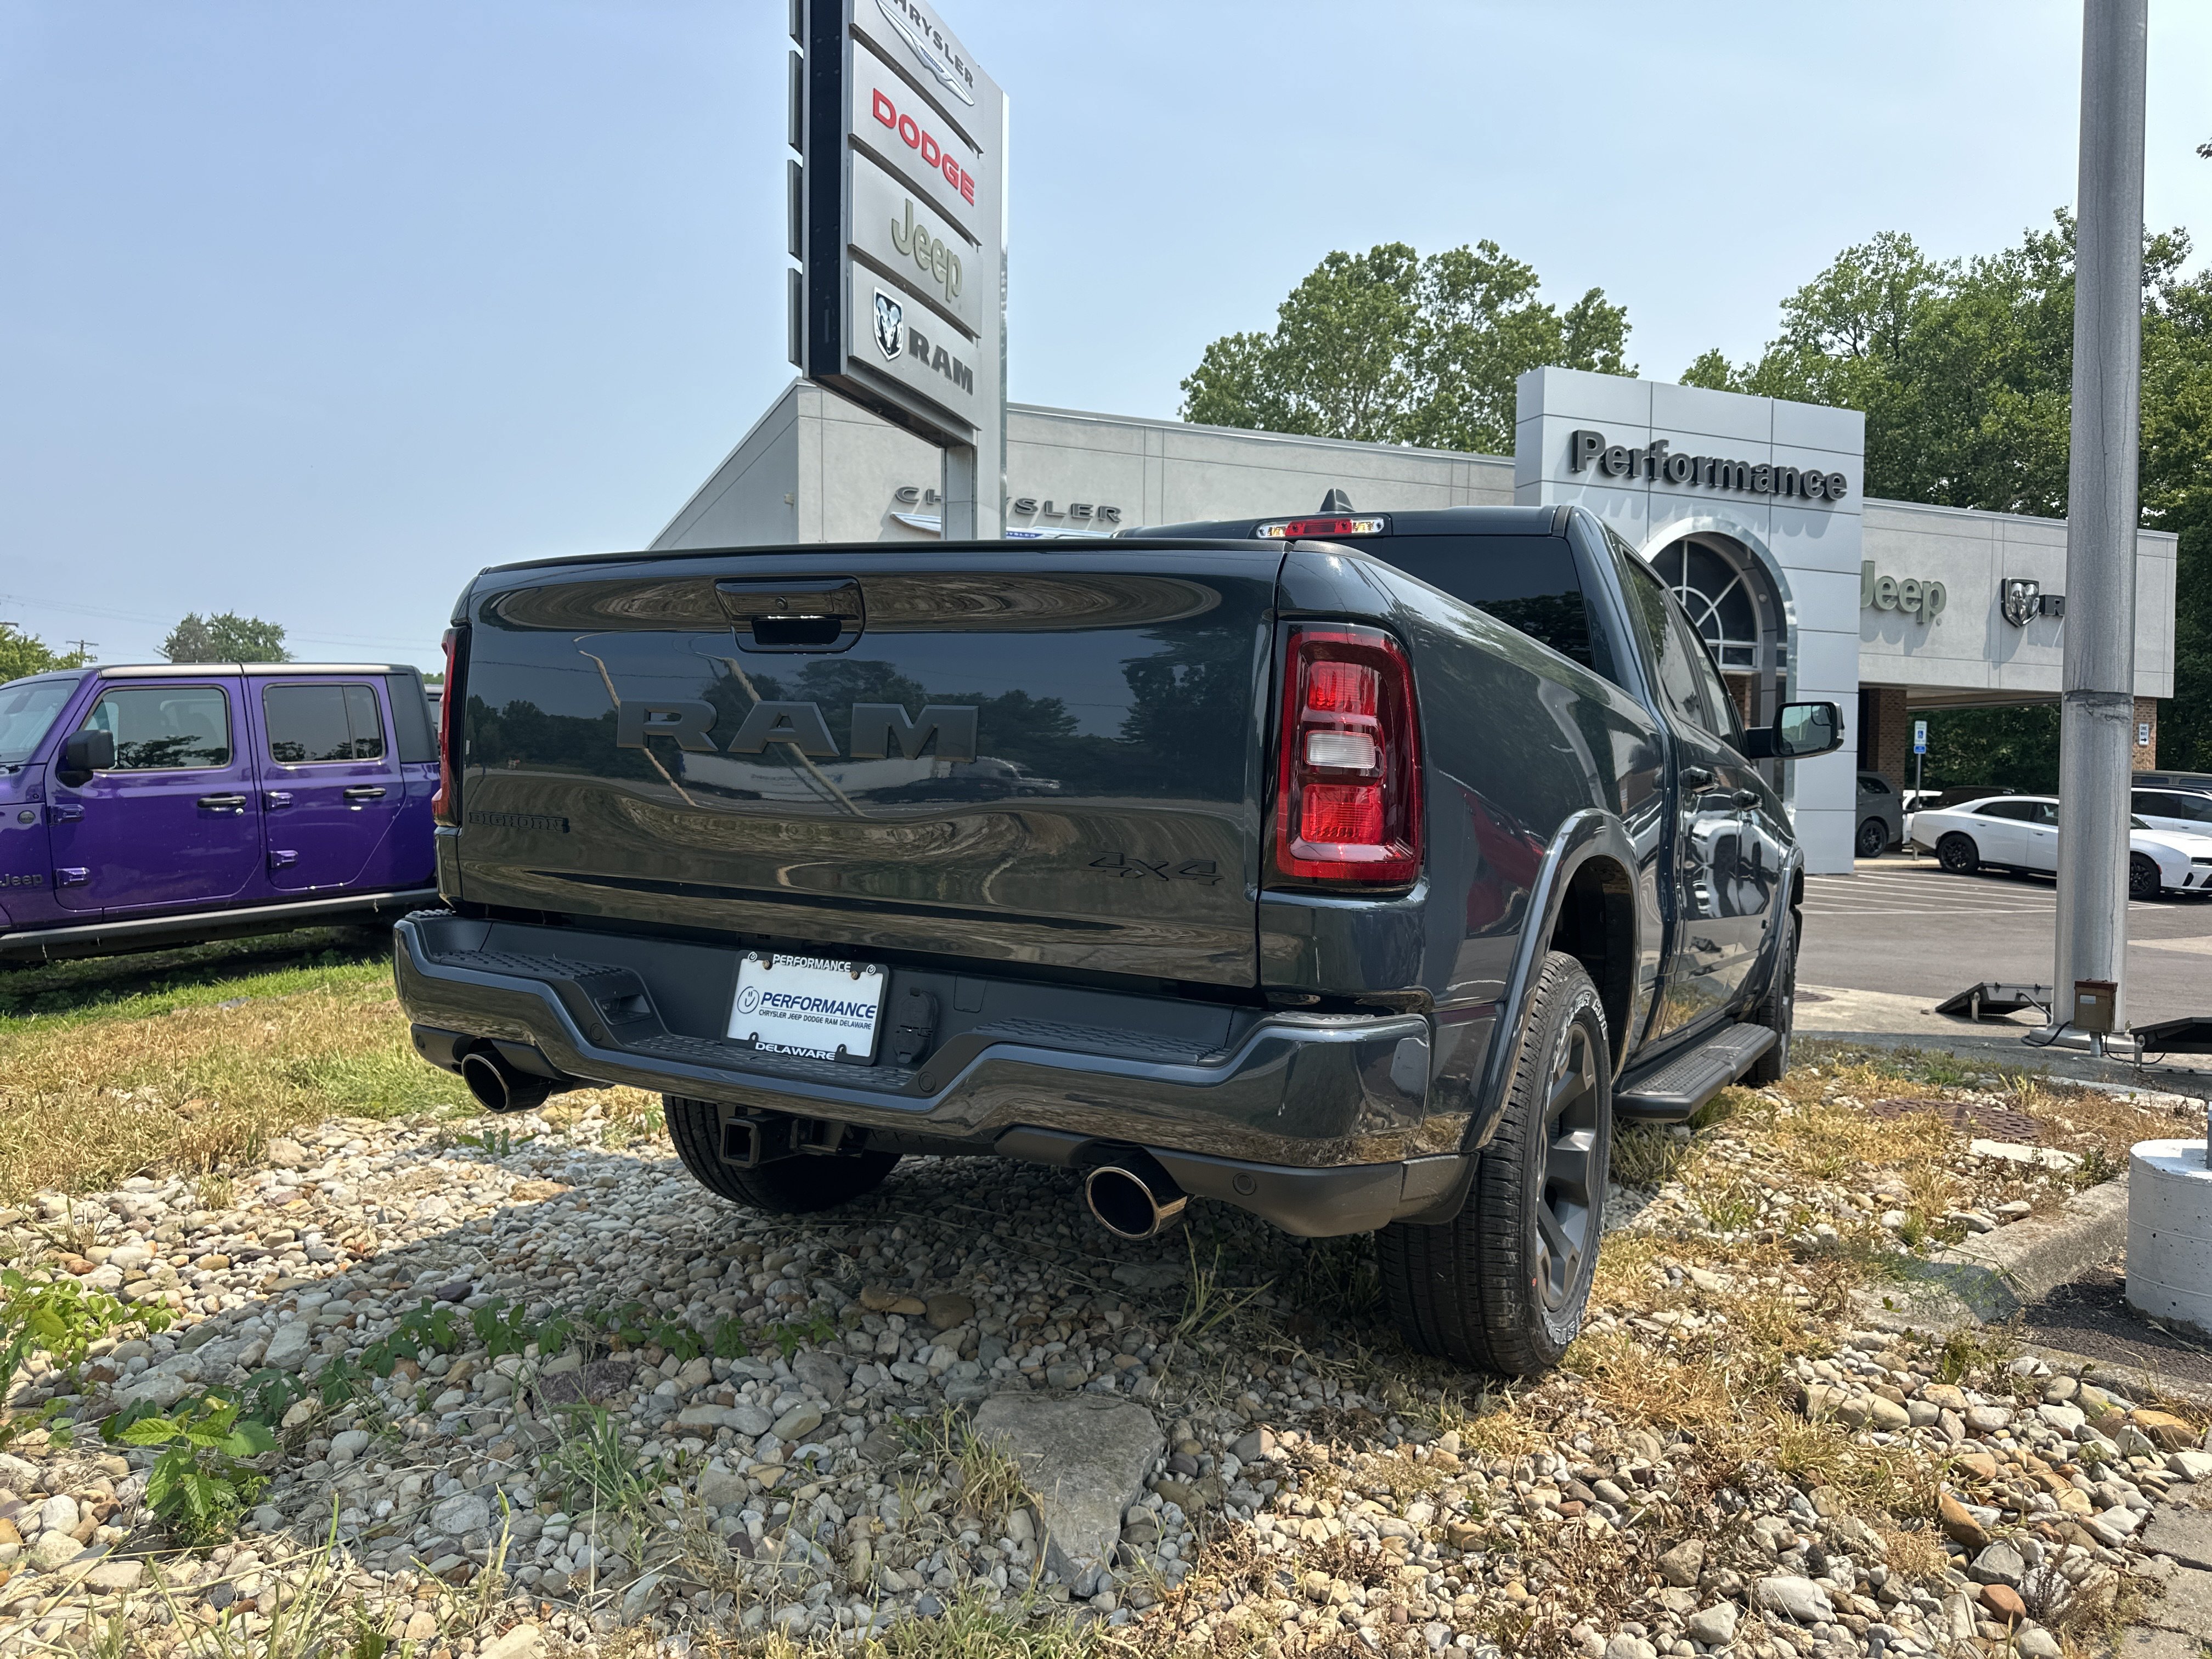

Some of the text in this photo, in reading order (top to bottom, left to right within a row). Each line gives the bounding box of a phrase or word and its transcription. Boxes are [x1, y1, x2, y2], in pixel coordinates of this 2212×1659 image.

[893, 0, 973, 89] HRYSLER
[873, 88, 975, 206] DODGE
[891, 199, 963, 303] Jeep
[909, 327, 973, 396] RAM
[1572, 430, 1848, 501] Performance
[895, 486, 1122, 522] CHSLER
[1860, 560, 1946, 624] Jeep
[617, 698, 979, 763] RAM
[0, 873, 43, 887] Jeep
[772, 953, 851, 972] PERFORMANCE
[759, 1009, 787, 1019] CHRYSLER
[803, 1014, 823, 1024] DODGE
[825, 1017, 838, 1025] RAM
[839, 1020, 872, 1030] DELAWARE
[760, 992, 877, 1019] PERFORMANCE
[755, 1042, 836, 1060] DELAWARE
